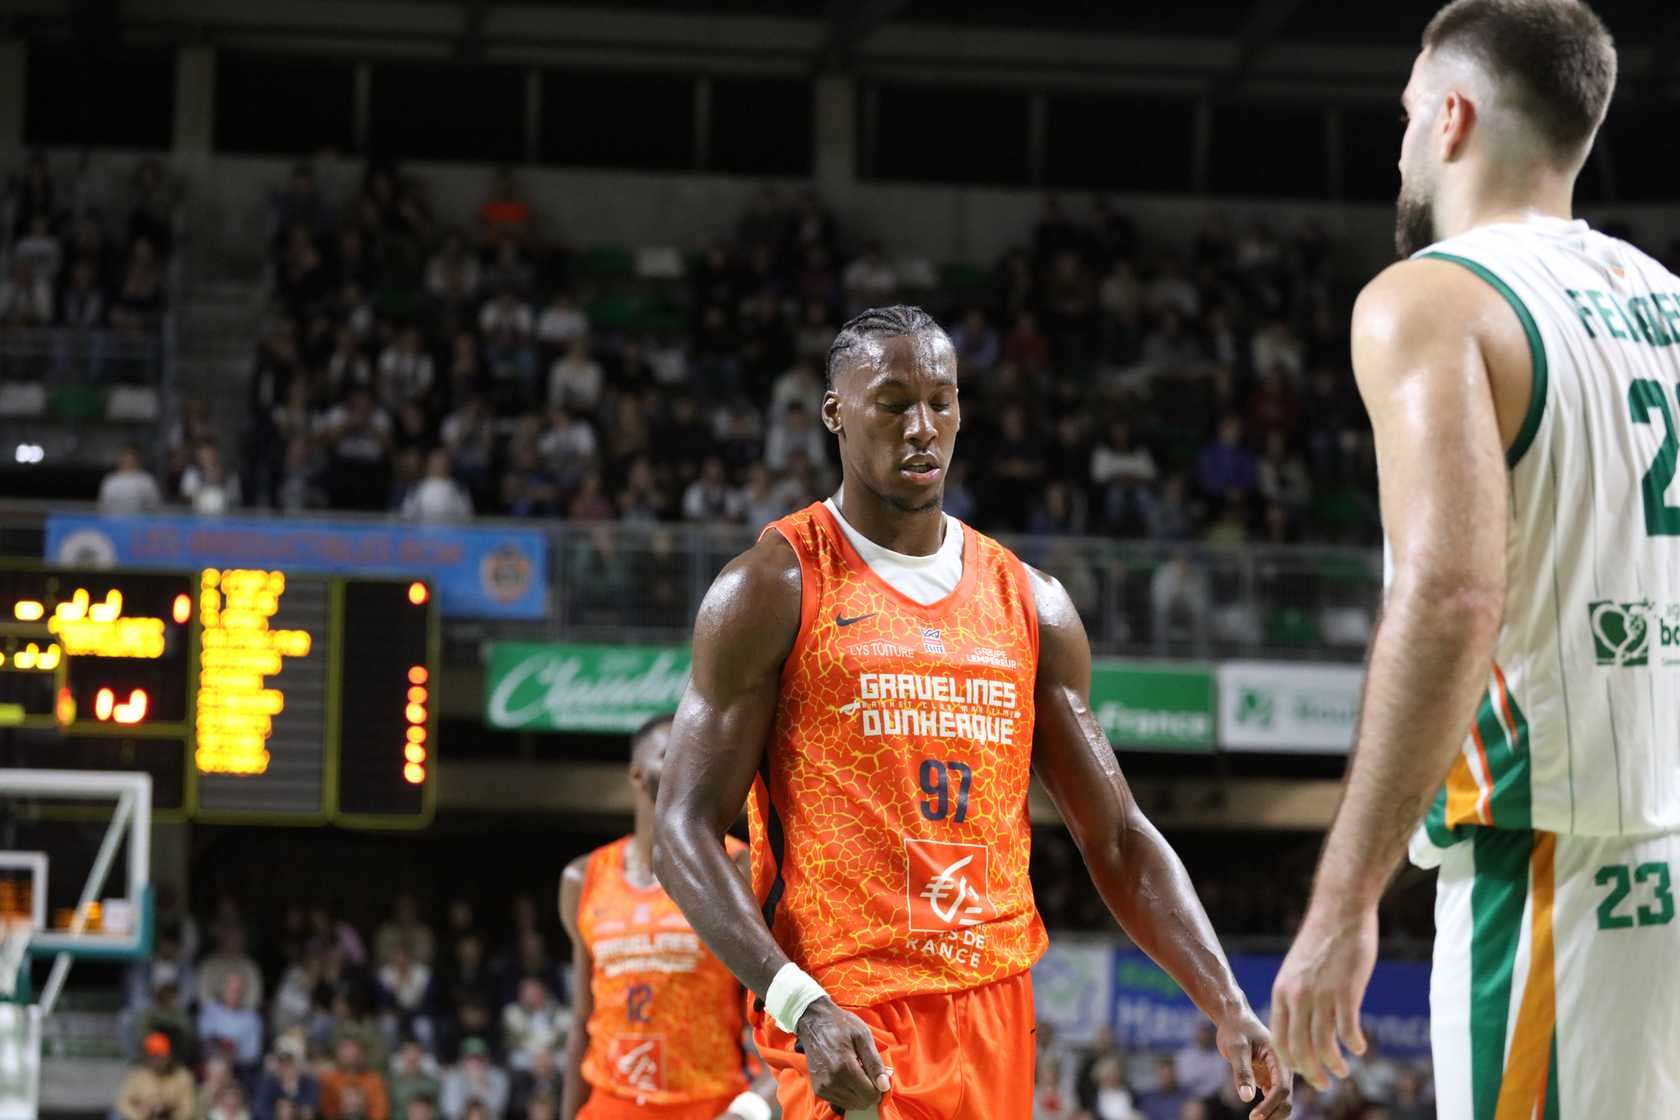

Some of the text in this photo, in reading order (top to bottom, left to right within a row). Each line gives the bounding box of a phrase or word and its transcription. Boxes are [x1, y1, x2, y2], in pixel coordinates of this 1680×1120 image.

[1627, 378, 1680, 537] 2
[849, 645, 870, 657] LYS
[860, 672, 1016, 709] GRAVELINES
[862, 709, 1014, 746] DUNKERQUE
[919, 759, 972, 824] 97
[1594, 861, 1675, 931] 23
[905, 938, 981, 968] RANCE
[964, 929, 985, 950] DE
